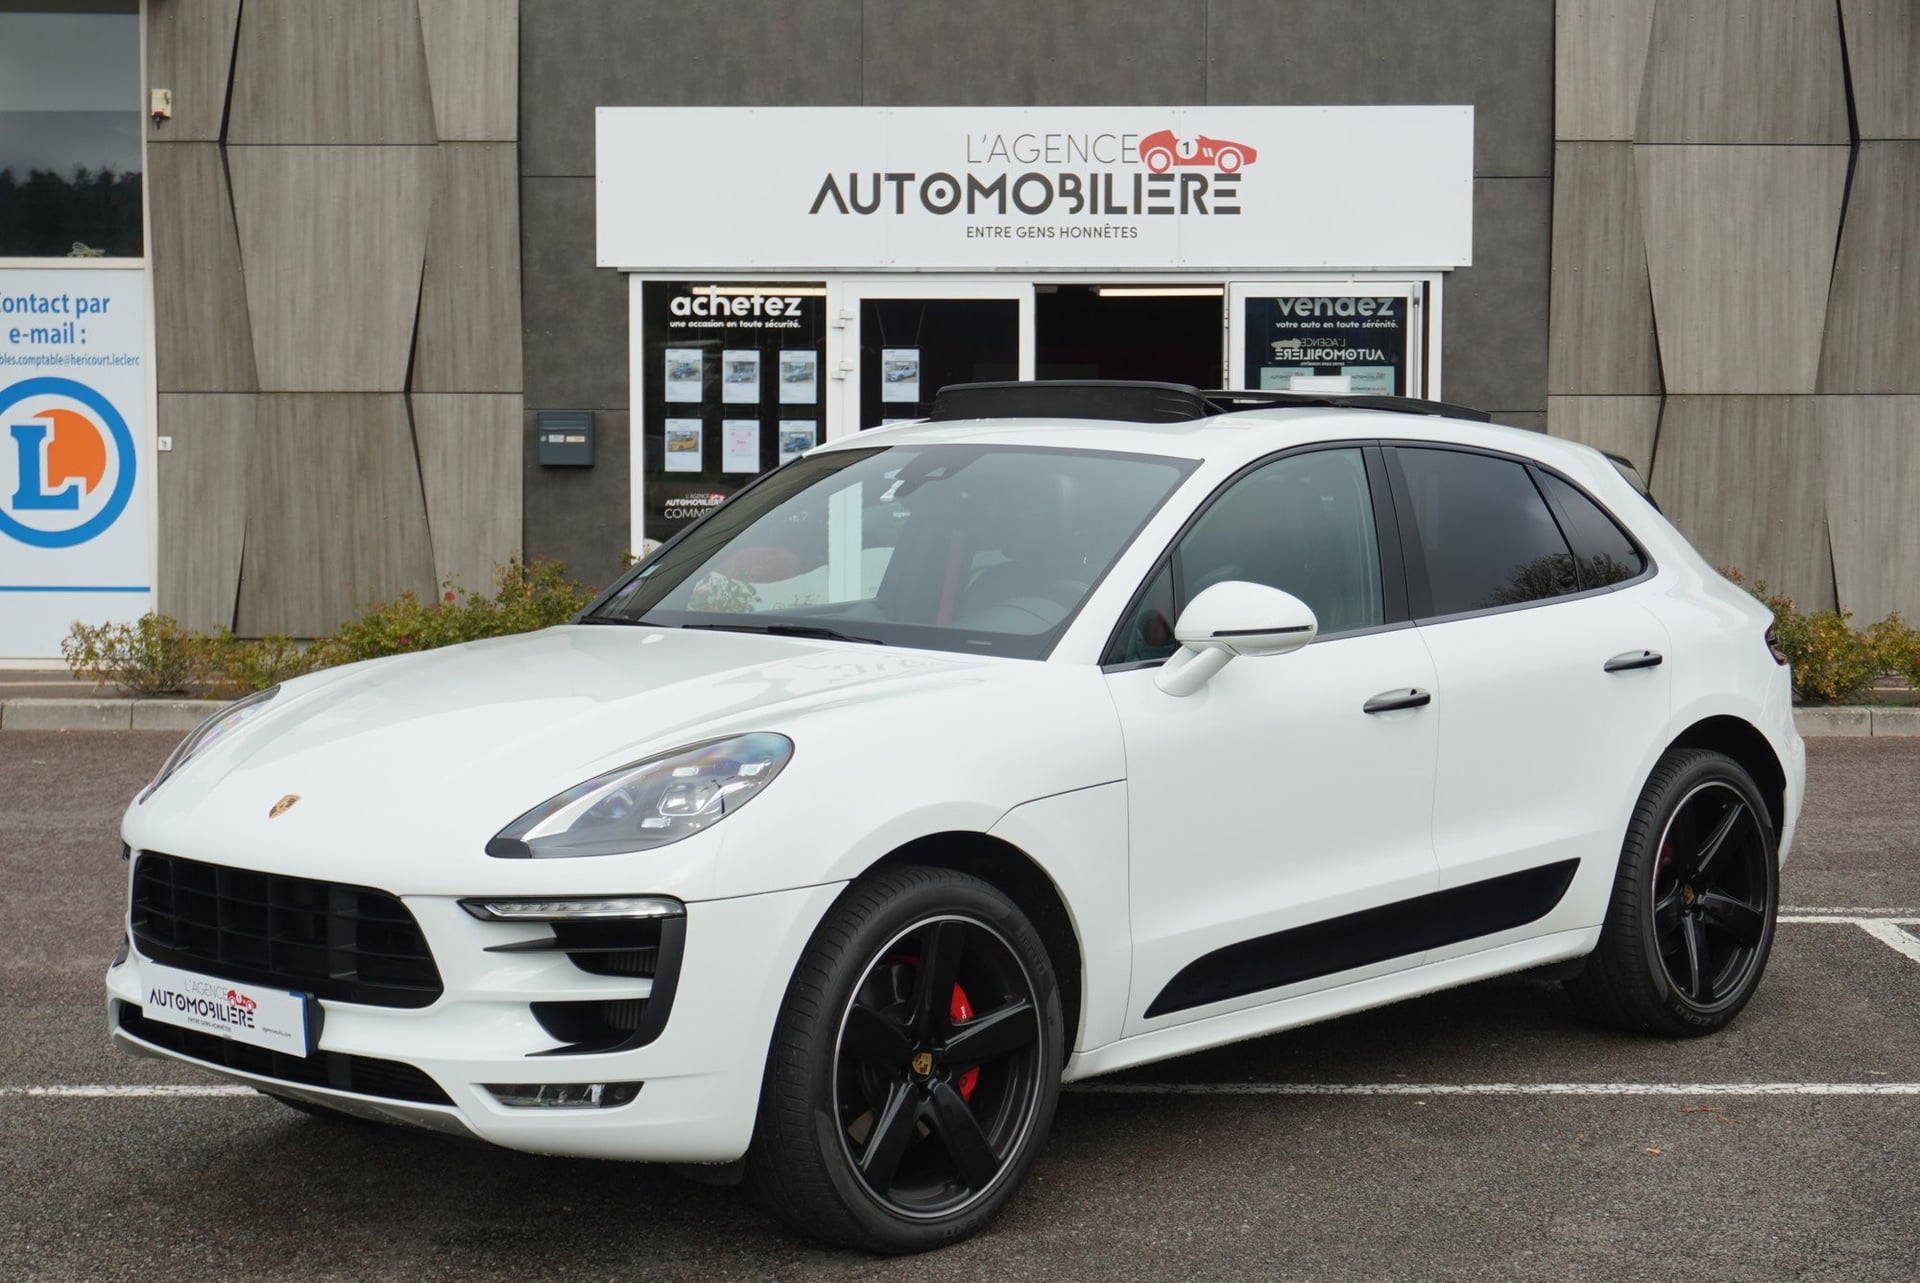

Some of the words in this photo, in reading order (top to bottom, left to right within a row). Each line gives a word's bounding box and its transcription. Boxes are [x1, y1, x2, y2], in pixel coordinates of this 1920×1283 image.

[966, 133, 1140, 164] L'AGENCE
[808, 172, 1242, 215] AUTOMOBILIERE
[966, 226, 1012, 239] ENTRE
[1016, 226, 1055, 239] GENS
[1060, 222, 1139, 239] HONNÊTES
[0, 294, 69, 313] ontact
[76, 298, 110, 319] par
[670, 285, 802, 316] achetez
[9, 322, 74, 344] e-mail
[688, 318, 724, 328] occasion
[739, 319, 763, 328] toute
[150, 987, 255, 1029] AUTOMOBILIERE
